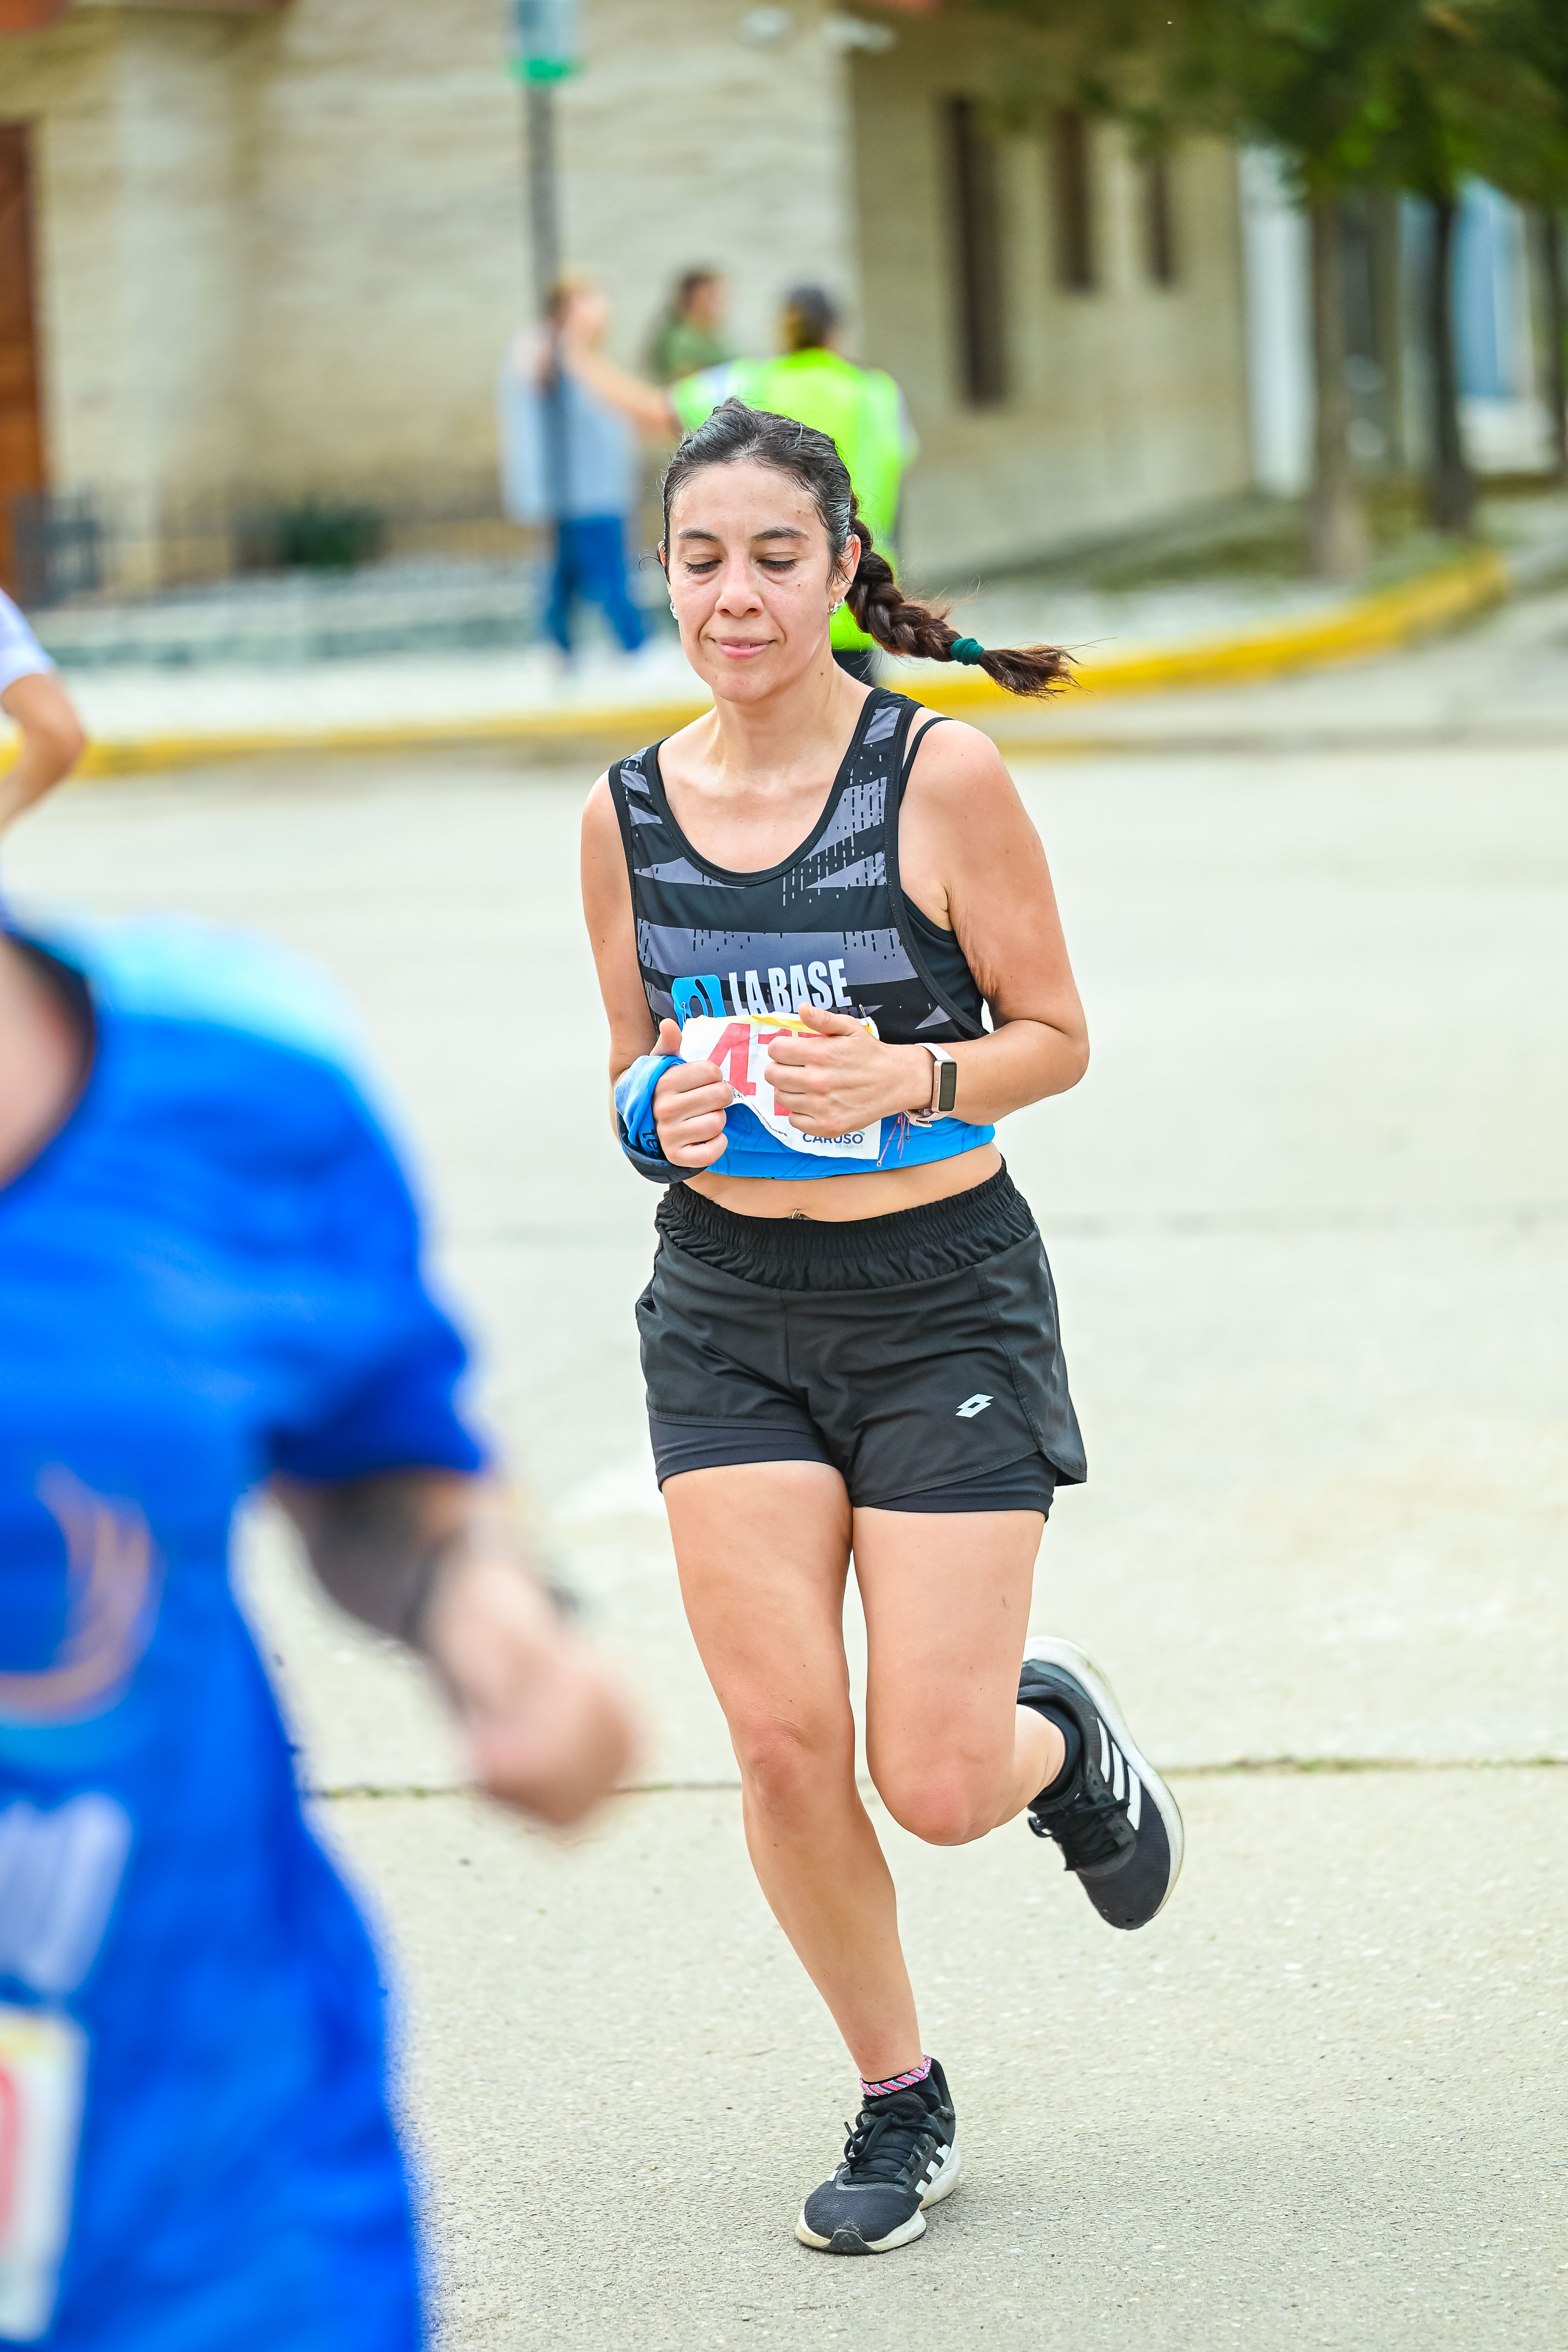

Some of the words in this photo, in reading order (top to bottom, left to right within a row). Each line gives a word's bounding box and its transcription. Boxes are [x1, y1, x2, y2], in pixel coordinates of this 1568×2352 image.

[728, 970, 769, 1016] LA
[768, 958, 852, 1013] BASE
[803, 1133, 863, 1144] CARUSO
